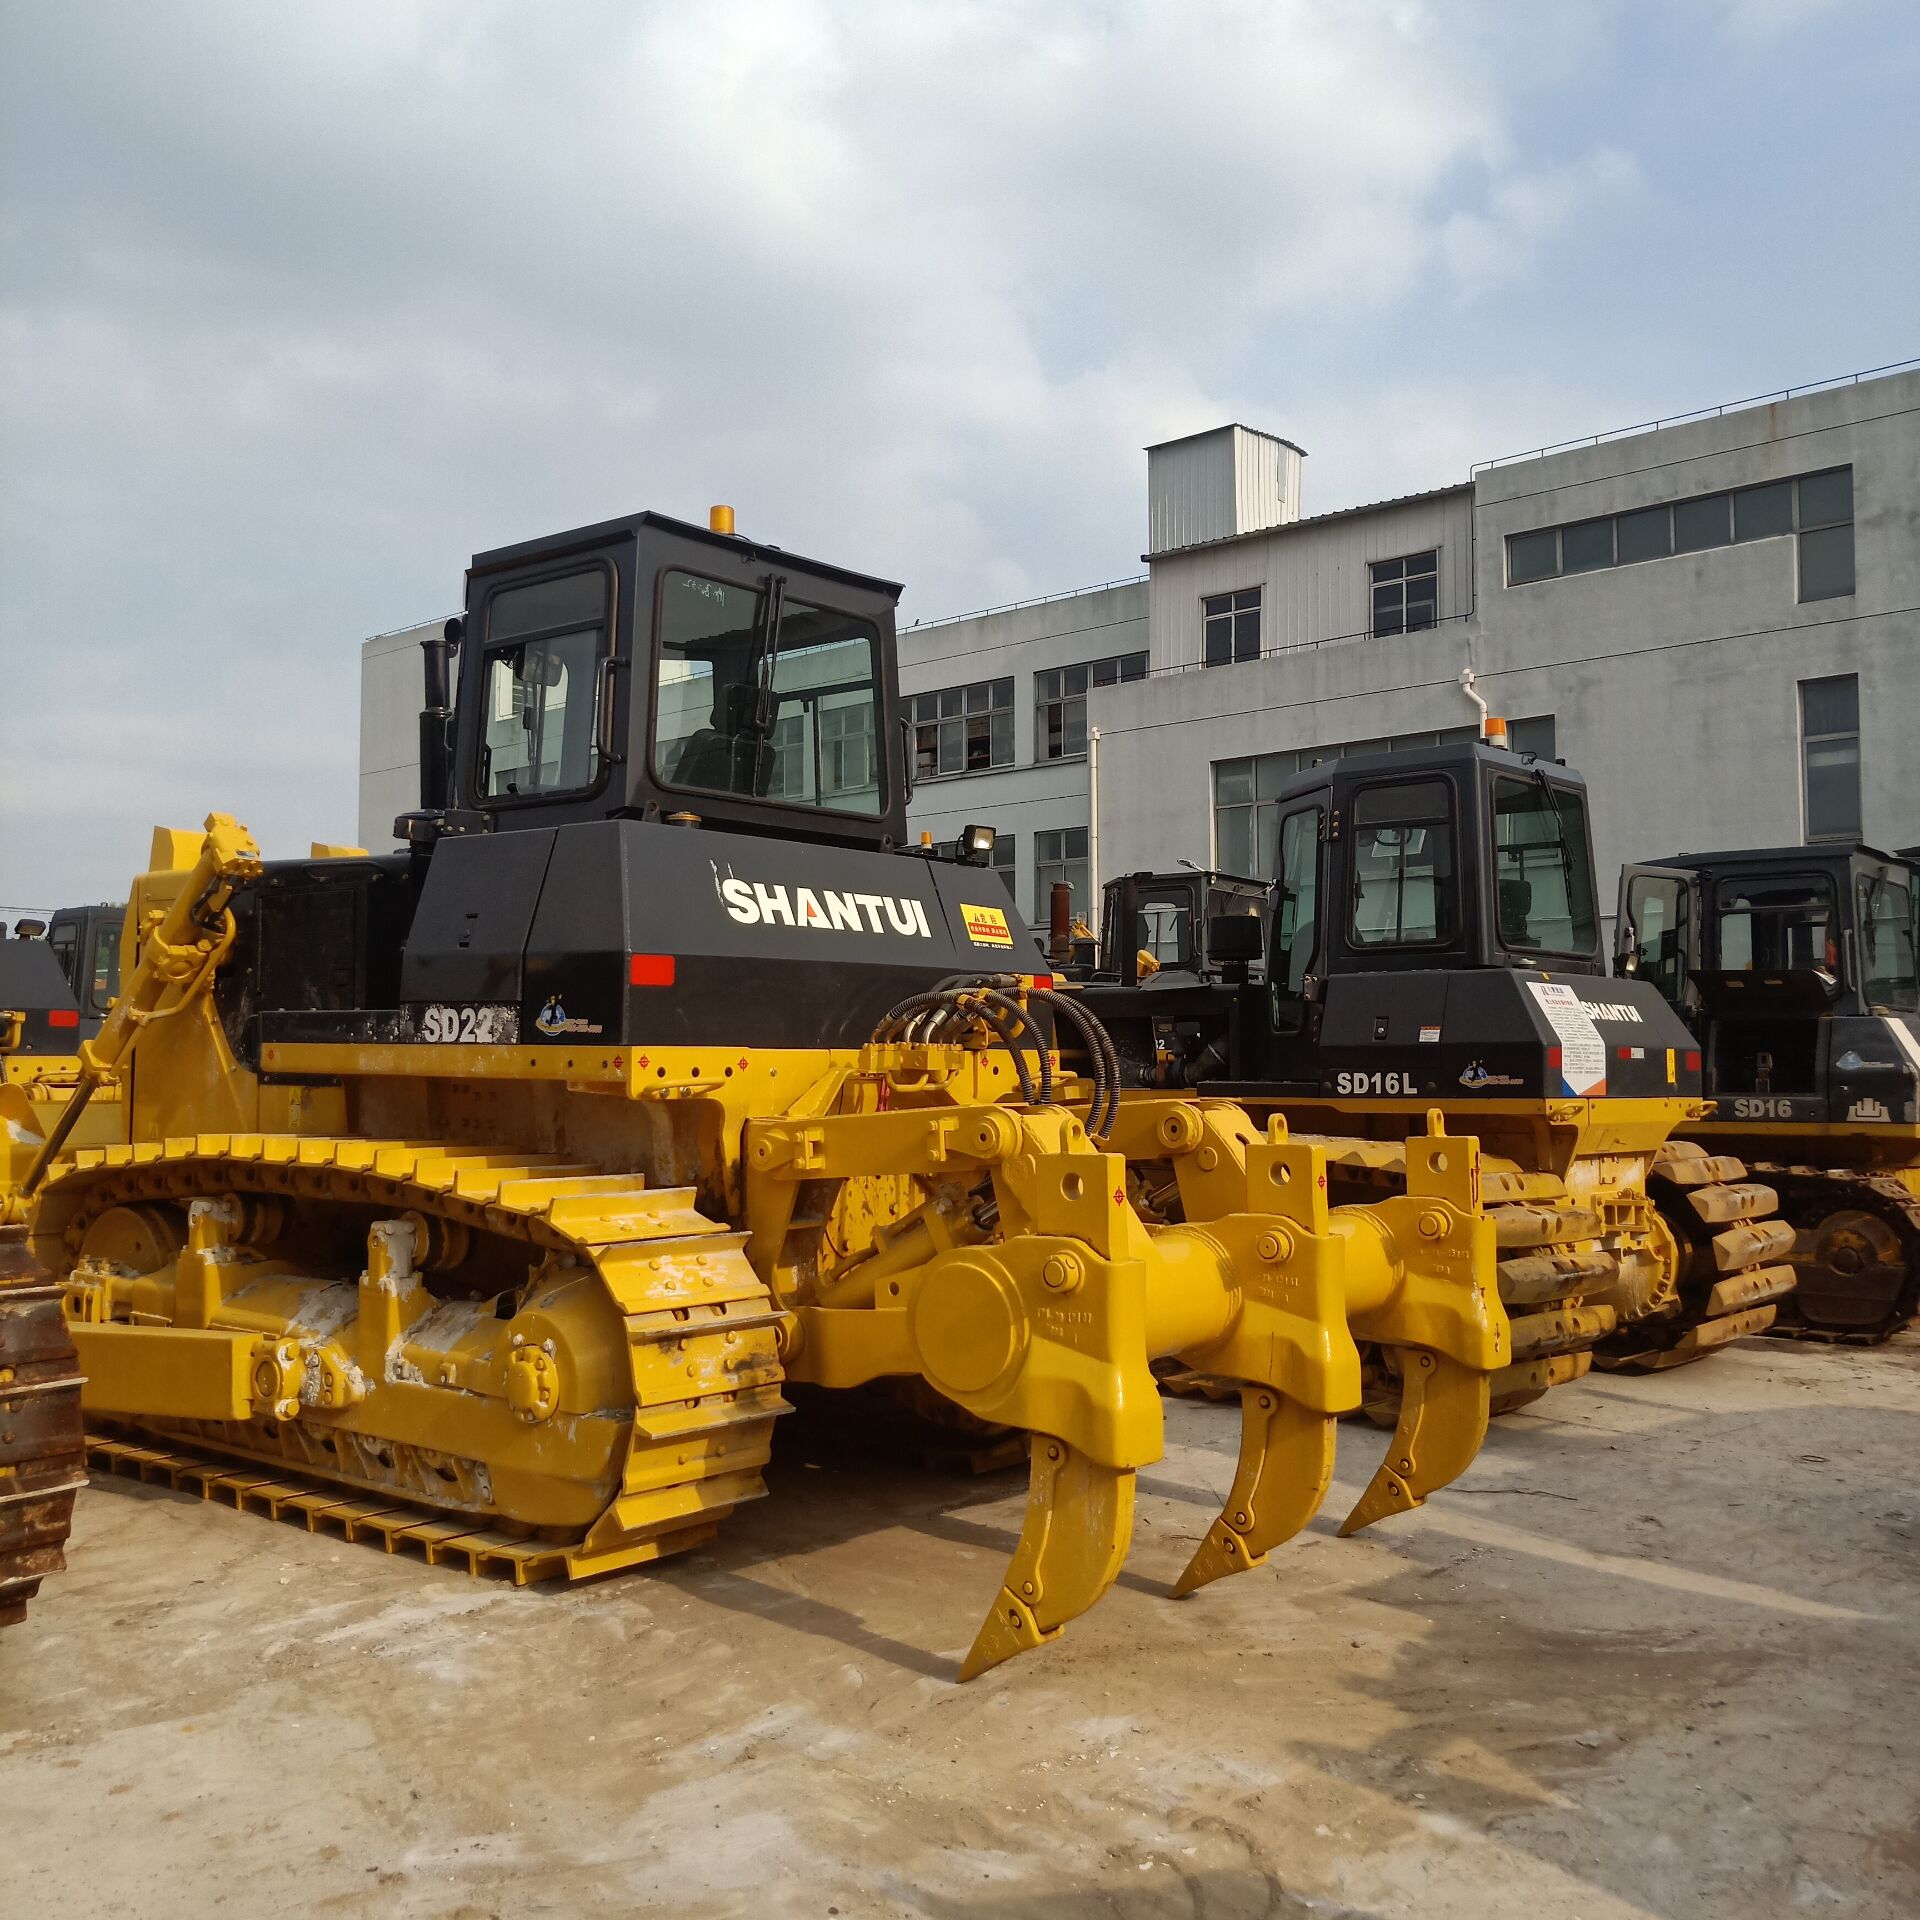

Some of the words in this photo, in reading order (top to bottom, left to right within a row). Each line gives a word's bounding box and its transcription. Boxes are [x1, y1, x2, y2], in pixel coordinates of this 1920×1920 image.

[721, 878, 932, 938] SHANTUI
[1581, 1001, 1643, 1023] SHANTUI
[423, 1007, 493, 1043] SD22
[1336, 1072, 1418, 1095] SD16L
[1734, 1098, 1793, 1118] SD16
